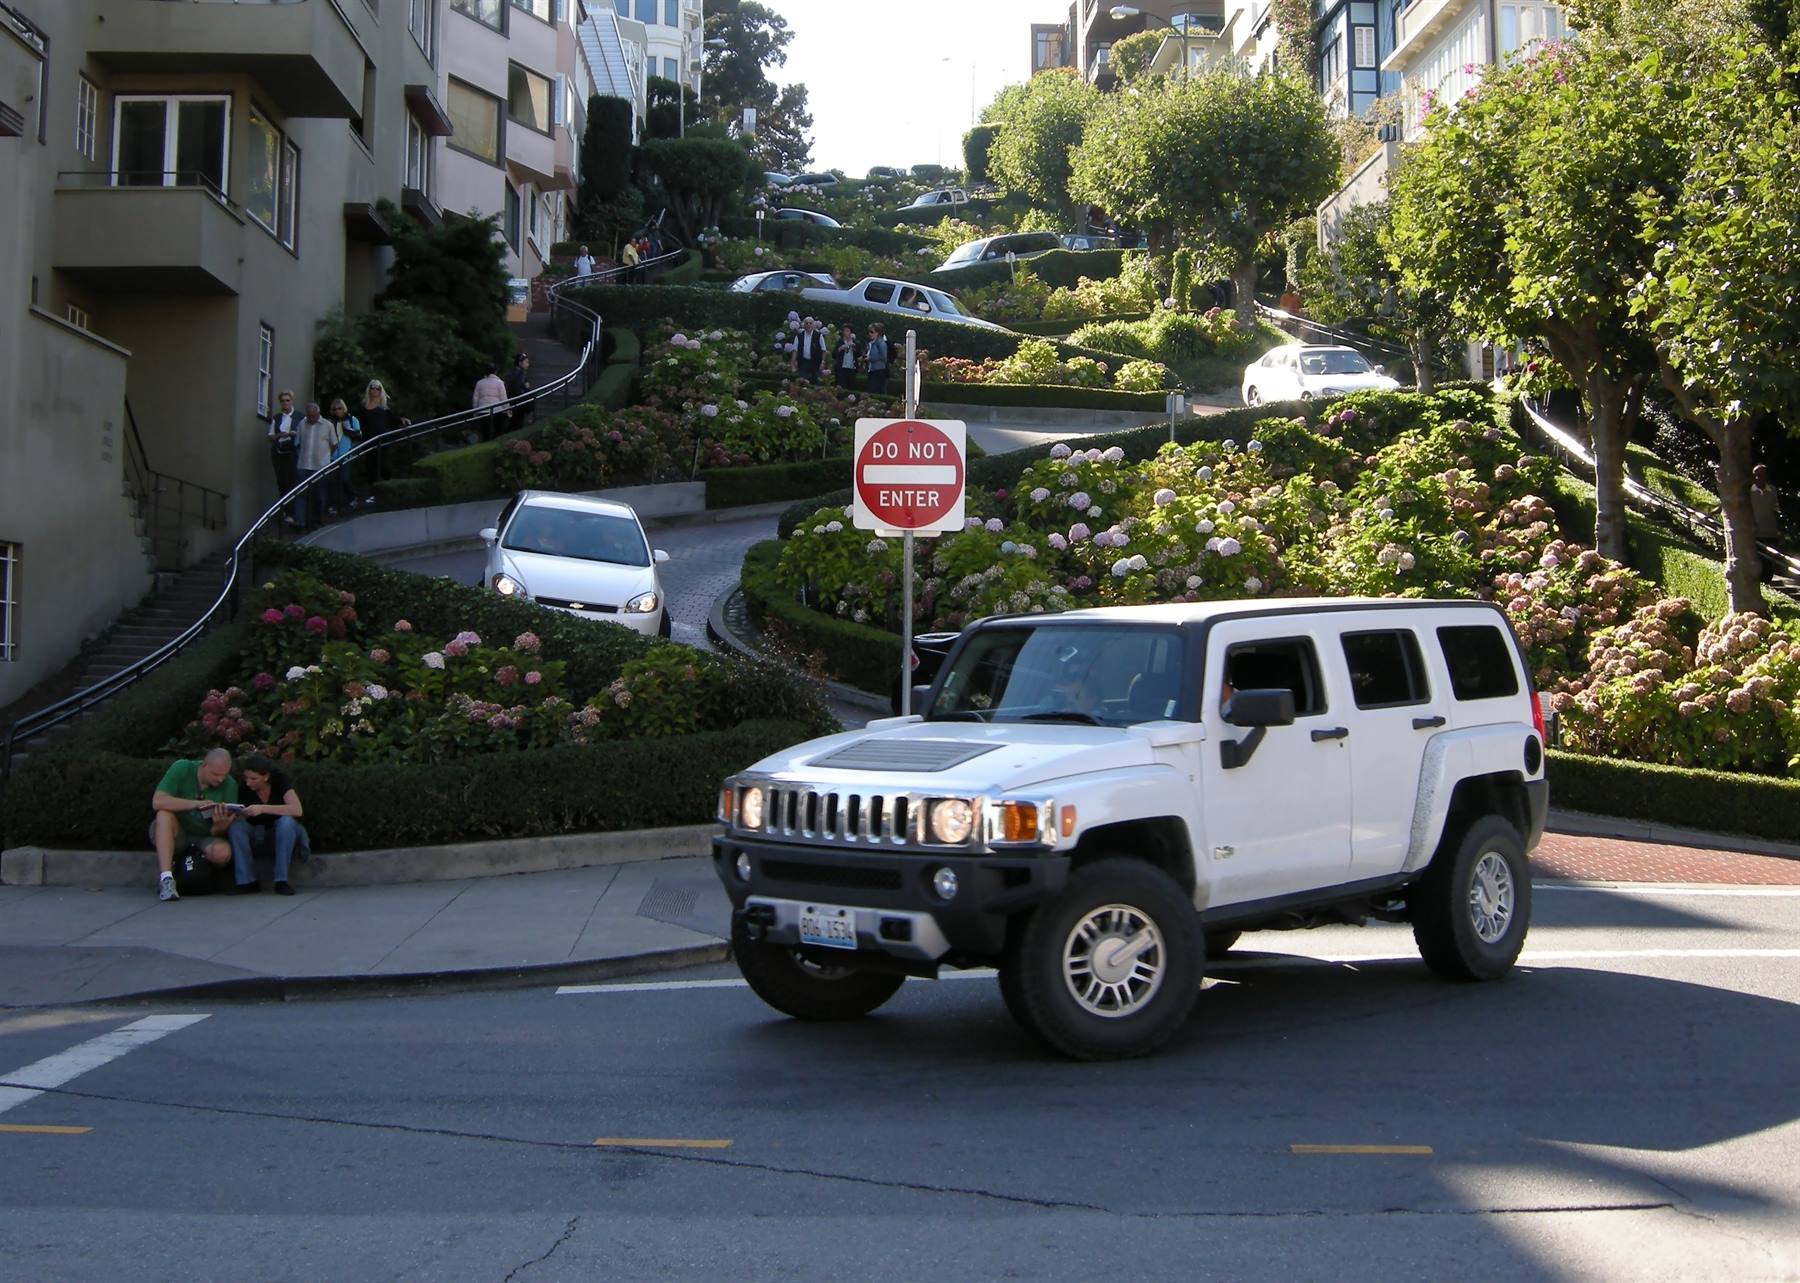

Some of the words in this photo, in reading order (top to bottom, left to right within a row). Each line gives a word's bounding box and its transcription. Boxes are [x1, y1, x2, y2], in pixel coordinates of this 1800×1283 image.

[872, 442, 899, 459] DO
[909, 442, 947, 460] NOT
[879, 490, 940, 507] ENTER
